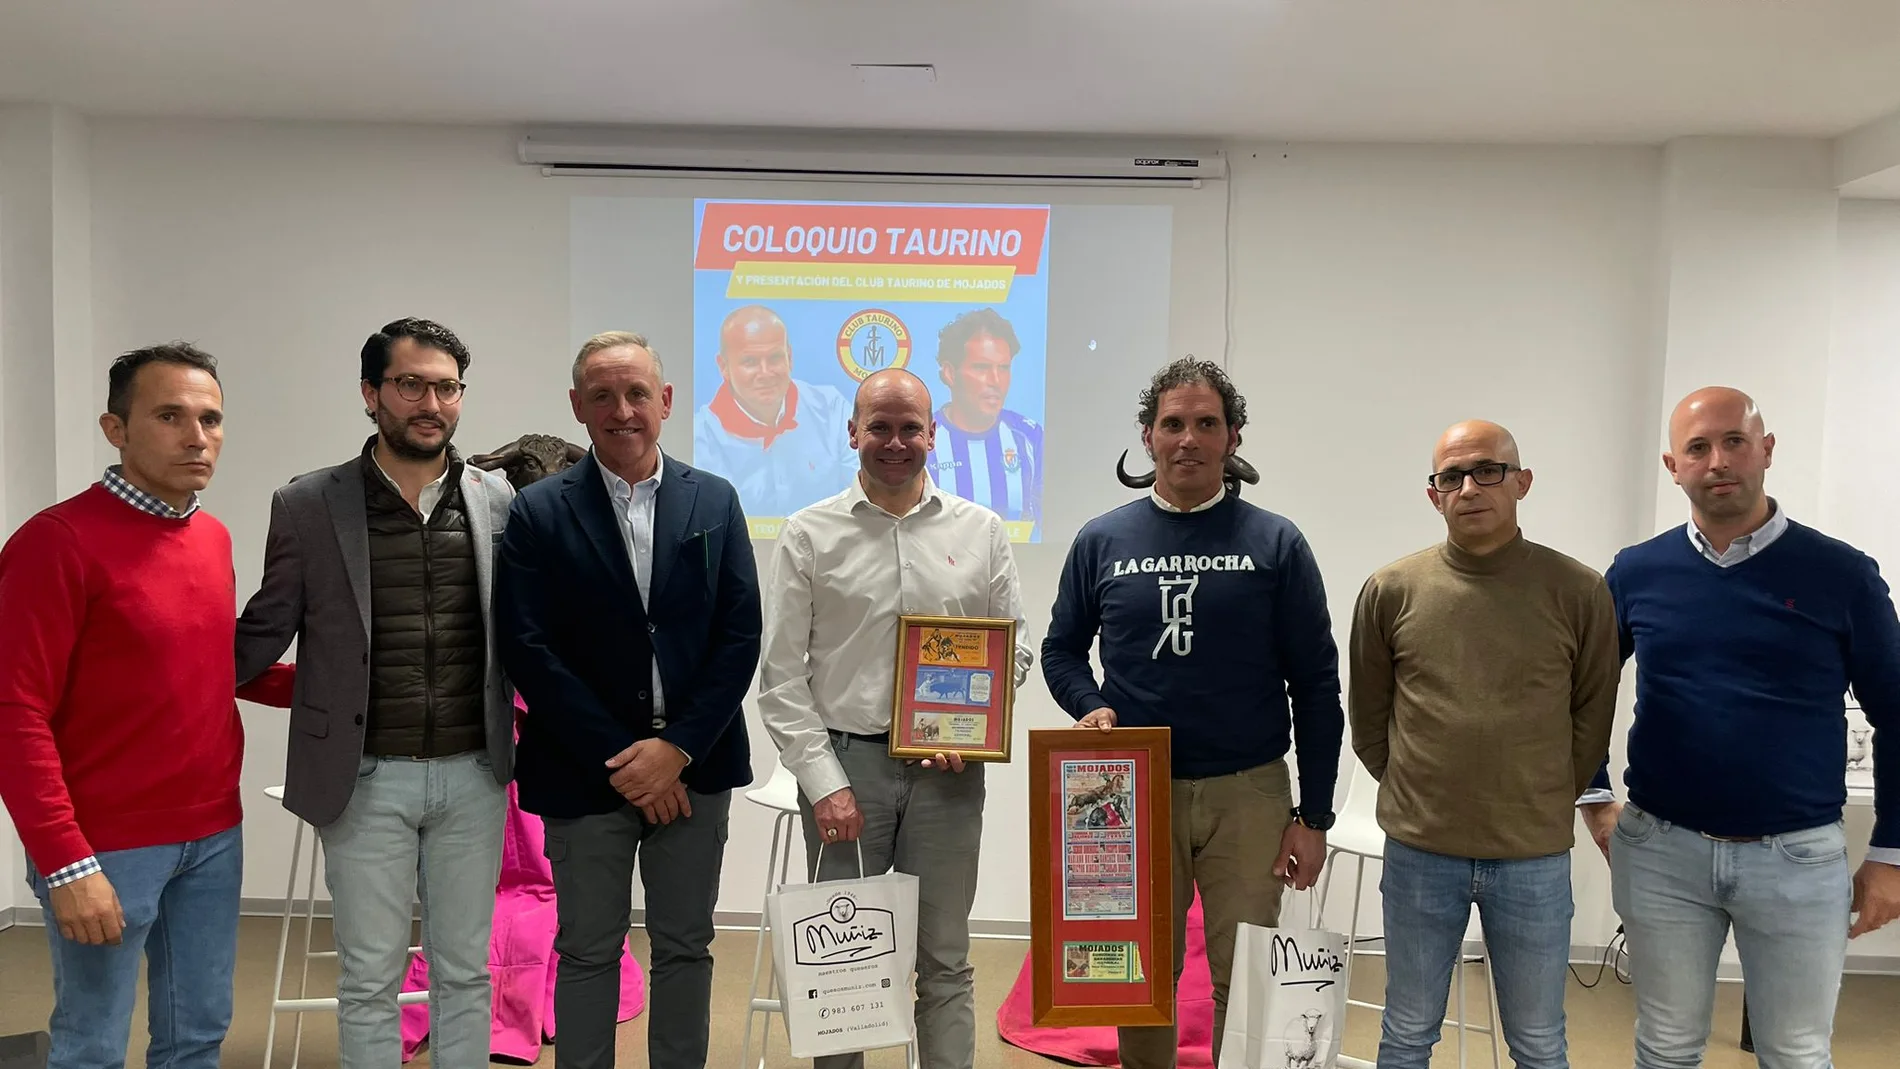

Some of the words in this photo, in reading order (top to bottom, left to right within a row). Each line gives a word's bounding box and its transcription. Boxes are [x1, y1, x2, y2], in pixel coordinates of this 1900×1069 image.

[723, 224, 877, 256] COLOQUIO
[886, 228, 1022, 257] TAURINO
[736, 275, 744, 285] Y
[745, 274, 830, 286] PRESENTACIÓN
[832, 277, 853, 287] DEL
[855, 277, 884, 288] CLUB
[887, 278, 935, 289] TAURINO
[937, 278, 951, 289] DE
[953, 279, 1006, 290] MOJADOS
[845, 318, 865, 337] CLUB
[866, 314, 903, 337] TAURINO
[1077, 764, 1130, 773] MOJADOS
[806, 924, 883, 955] Muñiz
[1271, 934, 1344, 977] Muñiz
[831, 1006, 846, 1015] 983
[850, 1004, 865, 1012] 607
[870, 1001, 884, 1010] 131
[817, 1028, 843, 1036] MOJADOS
